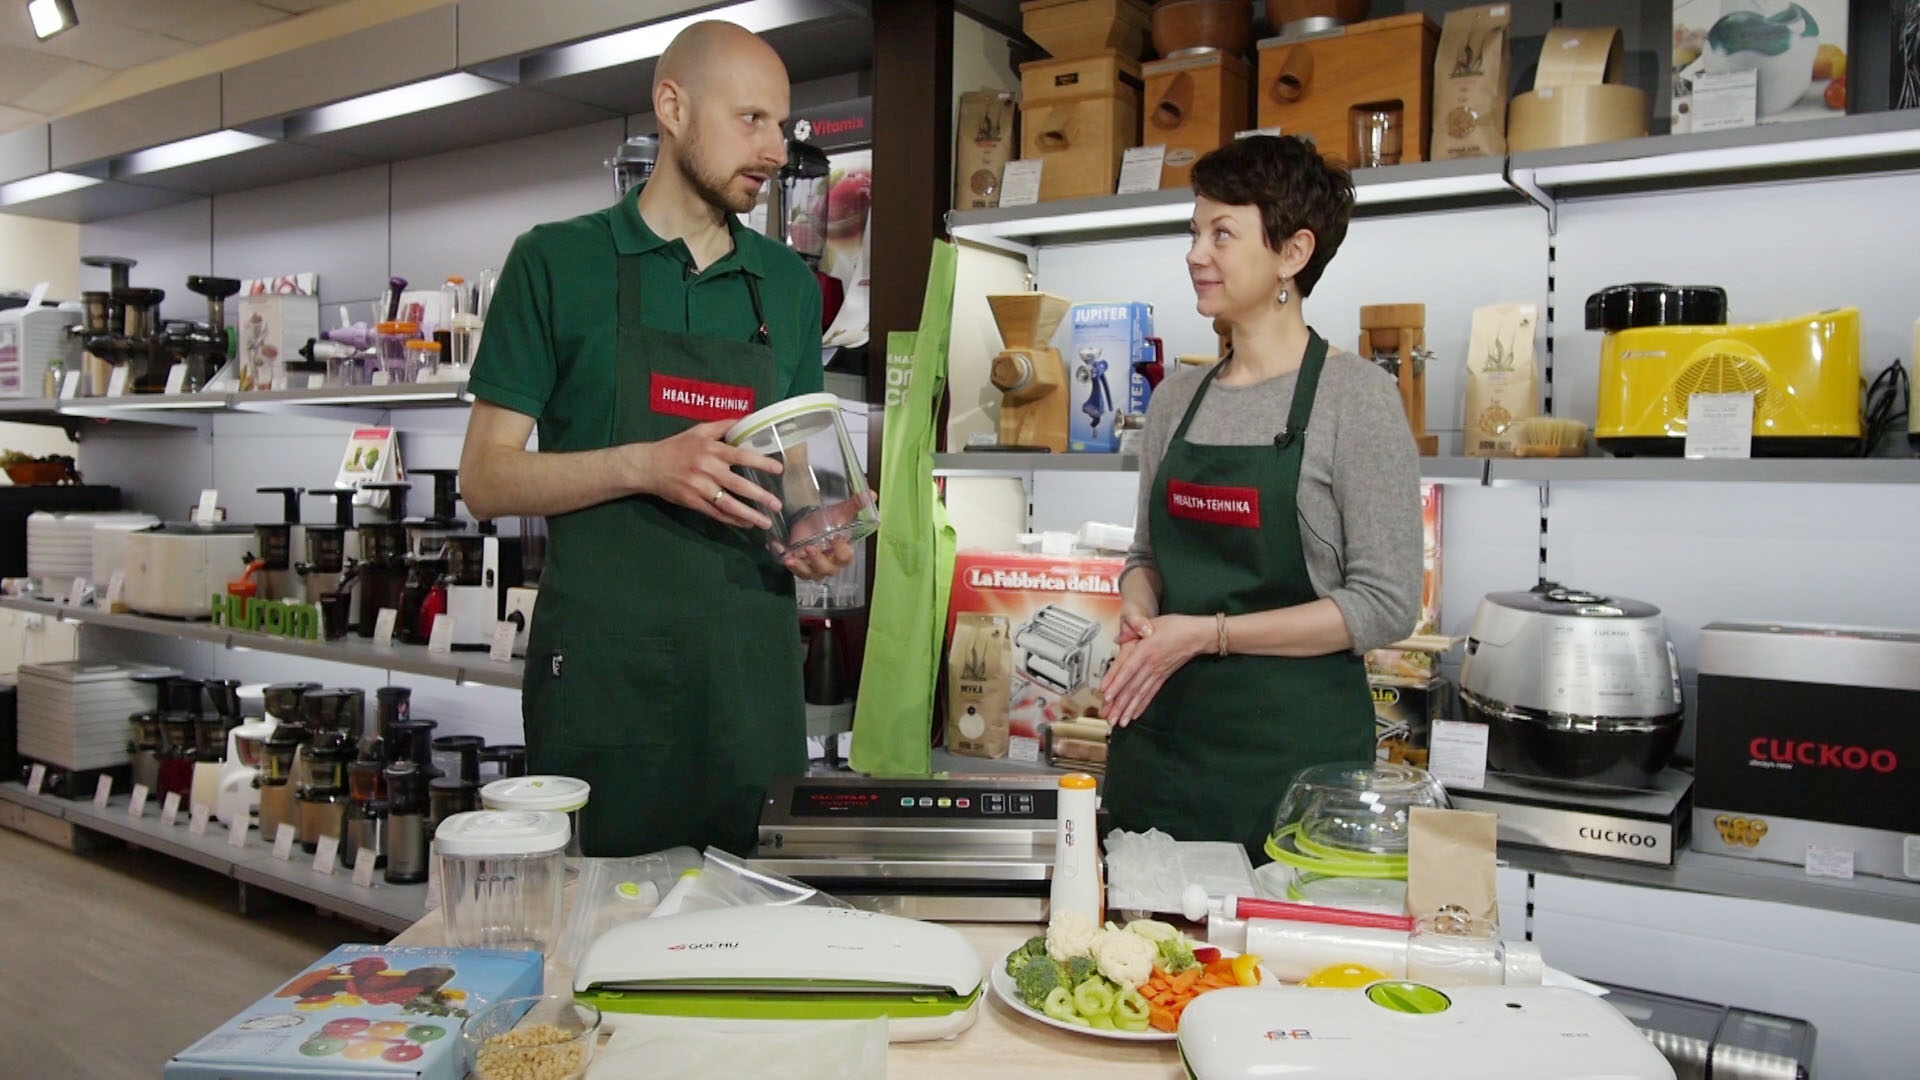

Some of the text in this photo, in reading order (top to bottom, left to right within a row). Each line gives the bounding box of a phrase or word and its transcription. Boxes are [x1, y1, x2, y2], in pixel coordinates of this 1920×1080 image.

[811, 116, 865, 136] Vitamix
[1074, 307, 1128, 322] JUPITER
[662, 387, 749, 412] HEALTH-TEHNIKA
[1172, 493, 1251, 515] HEALTH-TEHNIKA
[970, 568, 993, 587] La
[993, 569, 1066, 591] Fabbrica
[1067, 575, 1111, 594] della
[1749, 736, 1898, 773] CUCKOO
[1579, 827, 1657, 848] CUCKOO
